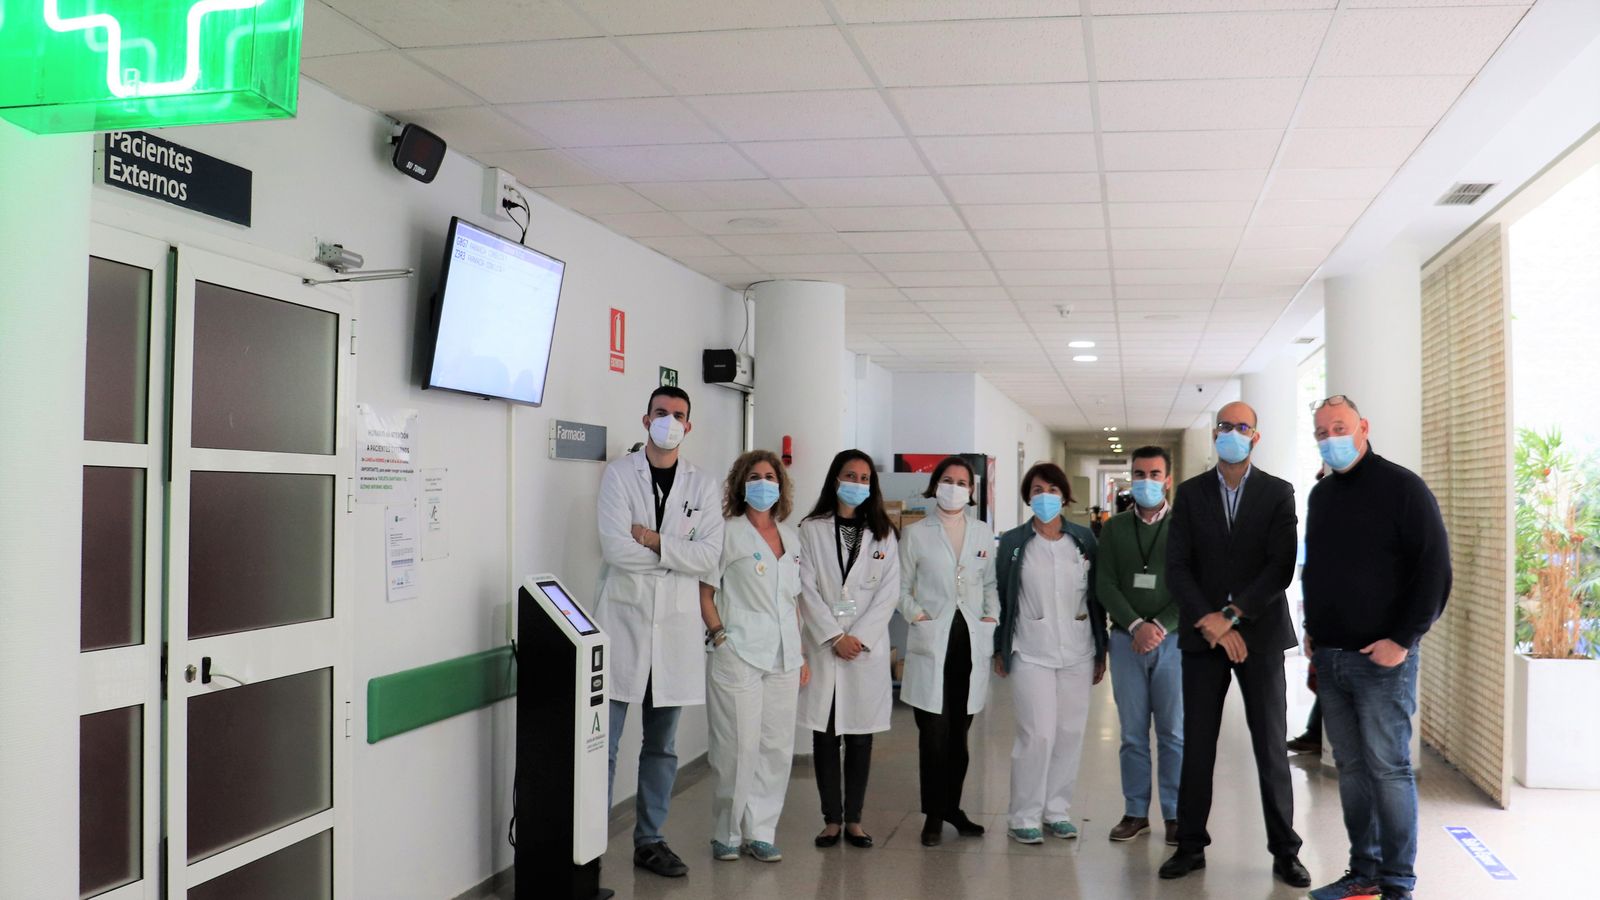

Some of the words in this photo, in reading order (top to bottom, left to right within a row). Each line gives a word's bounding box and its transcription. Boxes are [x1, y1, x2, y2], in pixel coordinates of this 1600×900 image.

[110, 131, 193, 174] Pacientes
[109, 155, 188, 201] Externos
[557, 425, 586, 441] Farmacia
